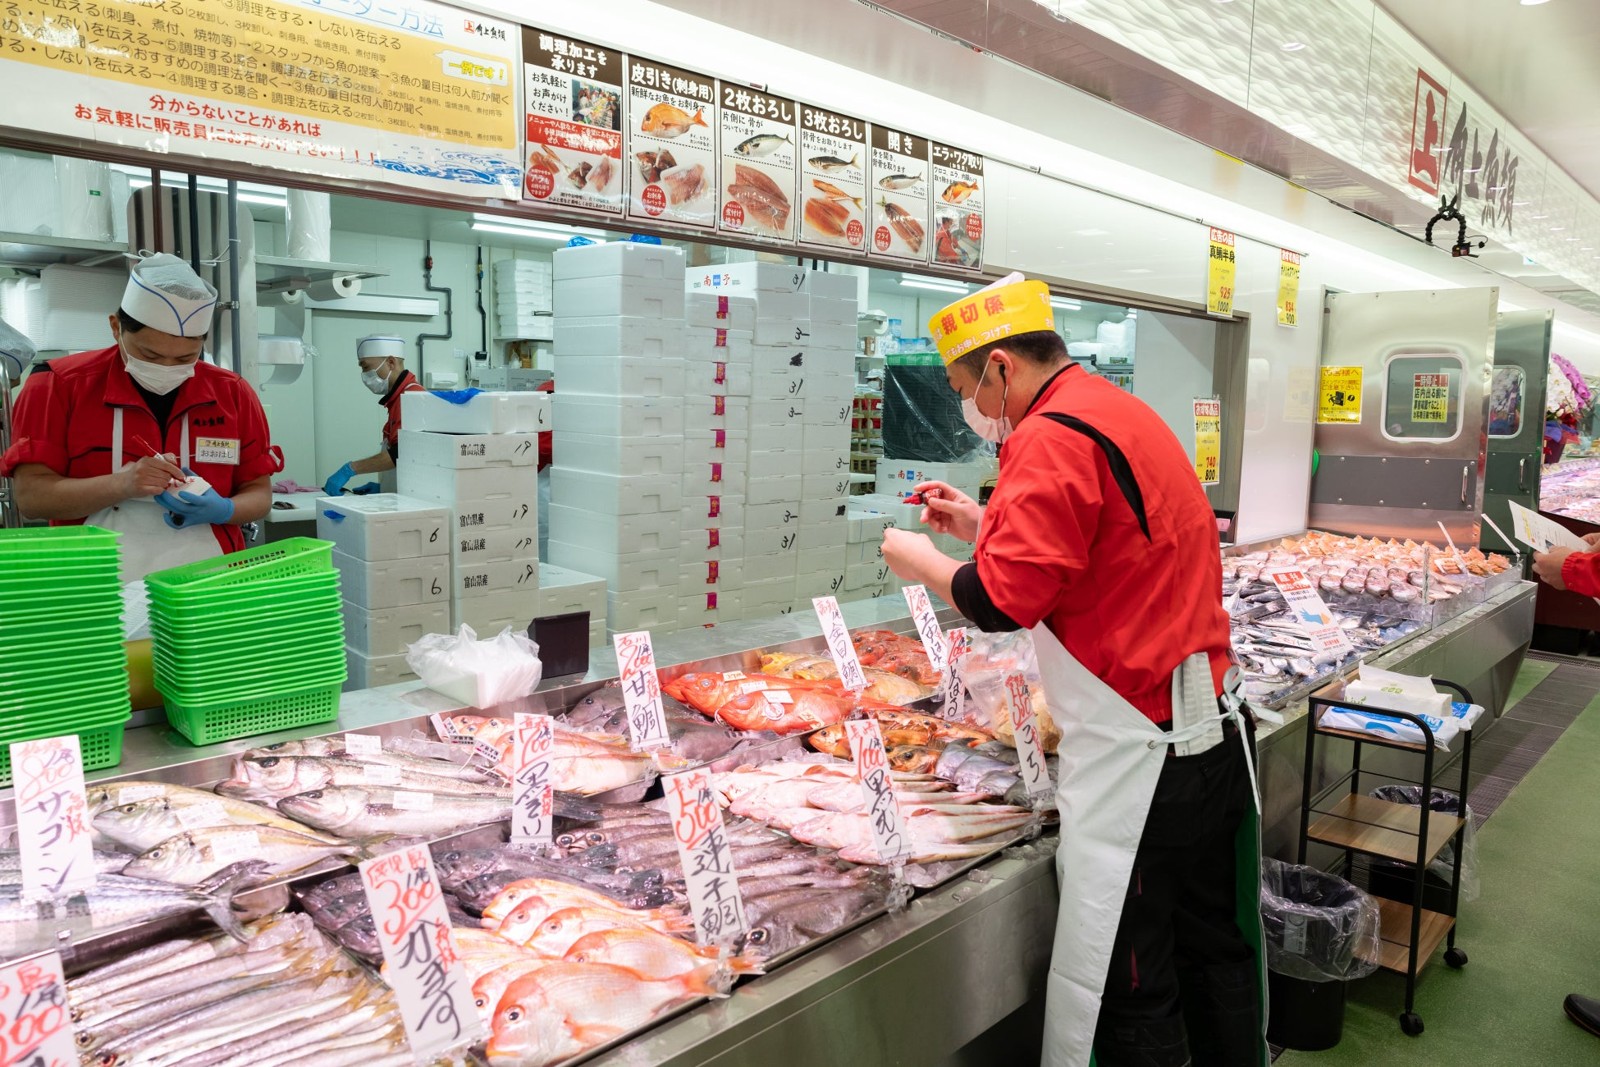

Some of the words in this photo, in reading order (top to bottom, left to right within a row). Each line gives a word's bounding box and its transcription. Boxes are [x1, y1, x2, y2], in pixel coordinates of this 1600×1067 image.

[538, 33, 607, 66] 調理加工を
[551, 53, 598, 78] 承ります
[532, 72, 568, 89] お気軽に
[631, 63, 714, 103] 皮引き(刺身用)
[149, 94, 322, 137] 分からないことがあれば
[724, 87, 792, 122] 2枚おろし
[804, 108, 863, 140] 3枚おろし
[887, 130, 913, 155] 開き
[941, 294, 1005, 336] 親切係
[200, 449, 234, 460] おおはし
[460, 443, 486, 456] 富山県産
[459, 512, 485, 528] 富山県産
[429, 528, 440, 543] 6
[460, 538, 486, 553] 富山県産
[431, 577, 442, 595] 6
[463, 574, 489, 589] 富山県産
[618, 633, 648, 648] 石川
[829, 621, 868, 687] 金目鯛
[624, 670, 663, 744] 甘鯛
[690, 824, 743, 945] 連子鯛
[374, 878, 435, 945] 300
